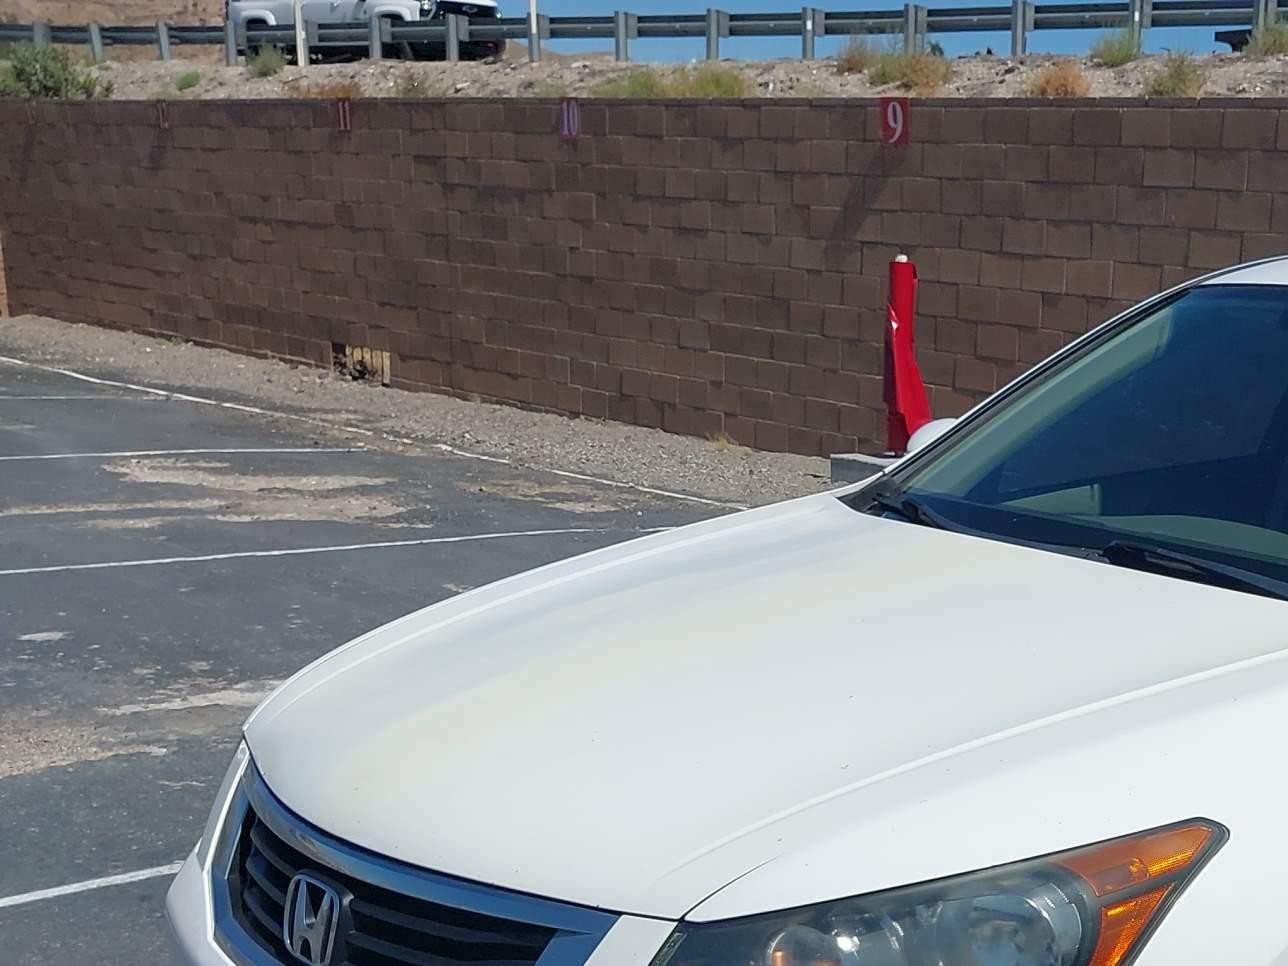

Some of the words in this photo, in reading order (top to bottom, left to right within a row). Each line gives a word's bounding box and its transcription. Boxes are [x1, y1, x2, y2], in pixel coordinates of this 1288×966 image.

[339, 101, 351, 130] 11
[562, 101, 577, 135] 10
[887, 101, 904, 143] 9
